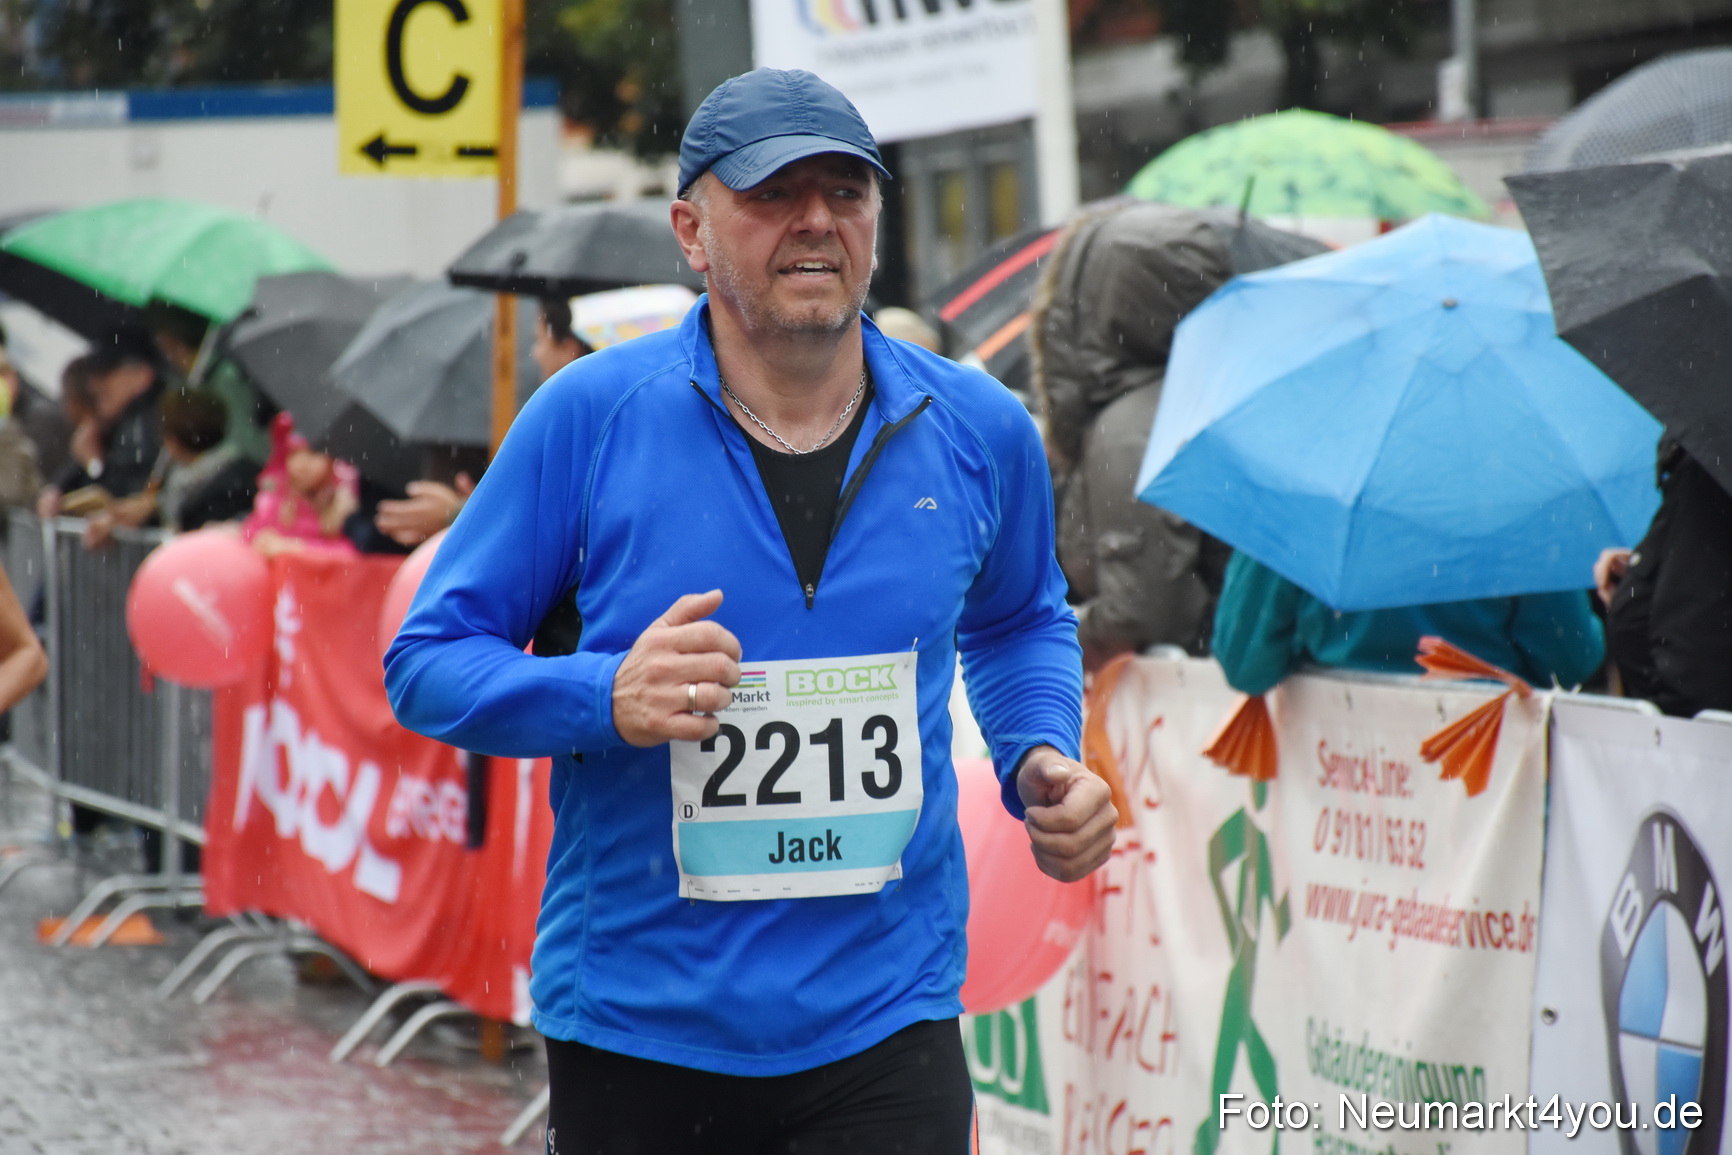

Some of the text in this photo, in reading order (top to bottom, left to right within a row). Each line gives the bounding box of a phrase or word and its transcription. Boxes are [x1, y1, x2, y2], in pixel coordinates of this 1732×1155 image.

[385, 0, 470, 114] C
[785, 663, 898, 697] BOCK
[786, 692, 899, 708] inspired by smart concepts
[700, 714, 903, 808] 2213
[683, 804, 694, 819] D
[1313, 806, 1330, 854] 0
[768, 829, 843, 864] Jack
[1610, 821, 1725, 978] BMW
